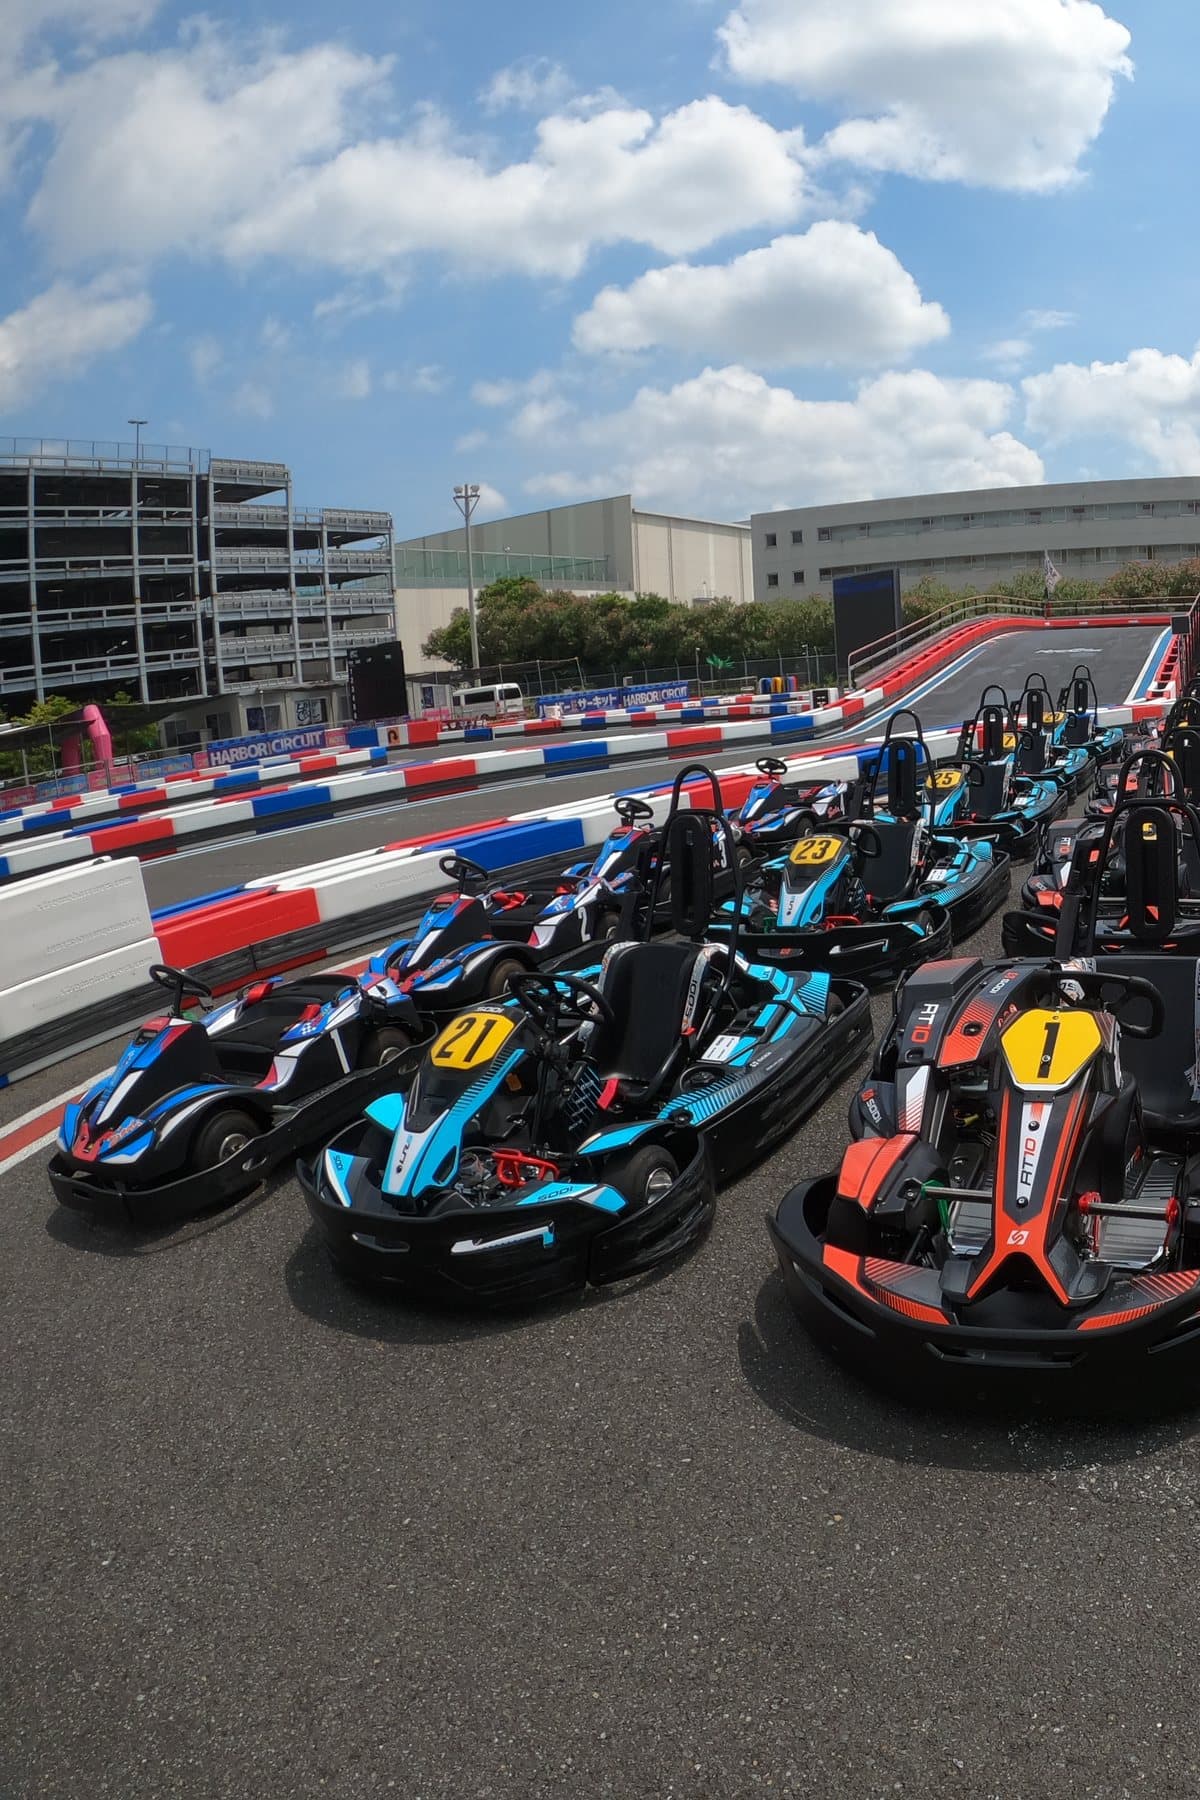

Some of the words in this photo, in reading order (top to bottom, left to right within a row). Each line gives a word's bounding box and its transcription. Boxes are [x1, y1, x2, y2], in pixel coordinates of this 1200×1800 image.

[623, 690, 659, 707] HARBOR
[210, 742, 269, 766] HARBOR
[271, 731, 323, 753] CIRCUIT
[795, 839, 832, 861] 23
[577, 906, 592, 943] 2
[435, 1016, 498, 1063] 21
[911, 1003, 940, 1044] RT10
[1037, 1022, 1061, 1079] 1
[866, 1098, 882, 1124] SODI
[1020, 1137, 1037, 1187] RT10
